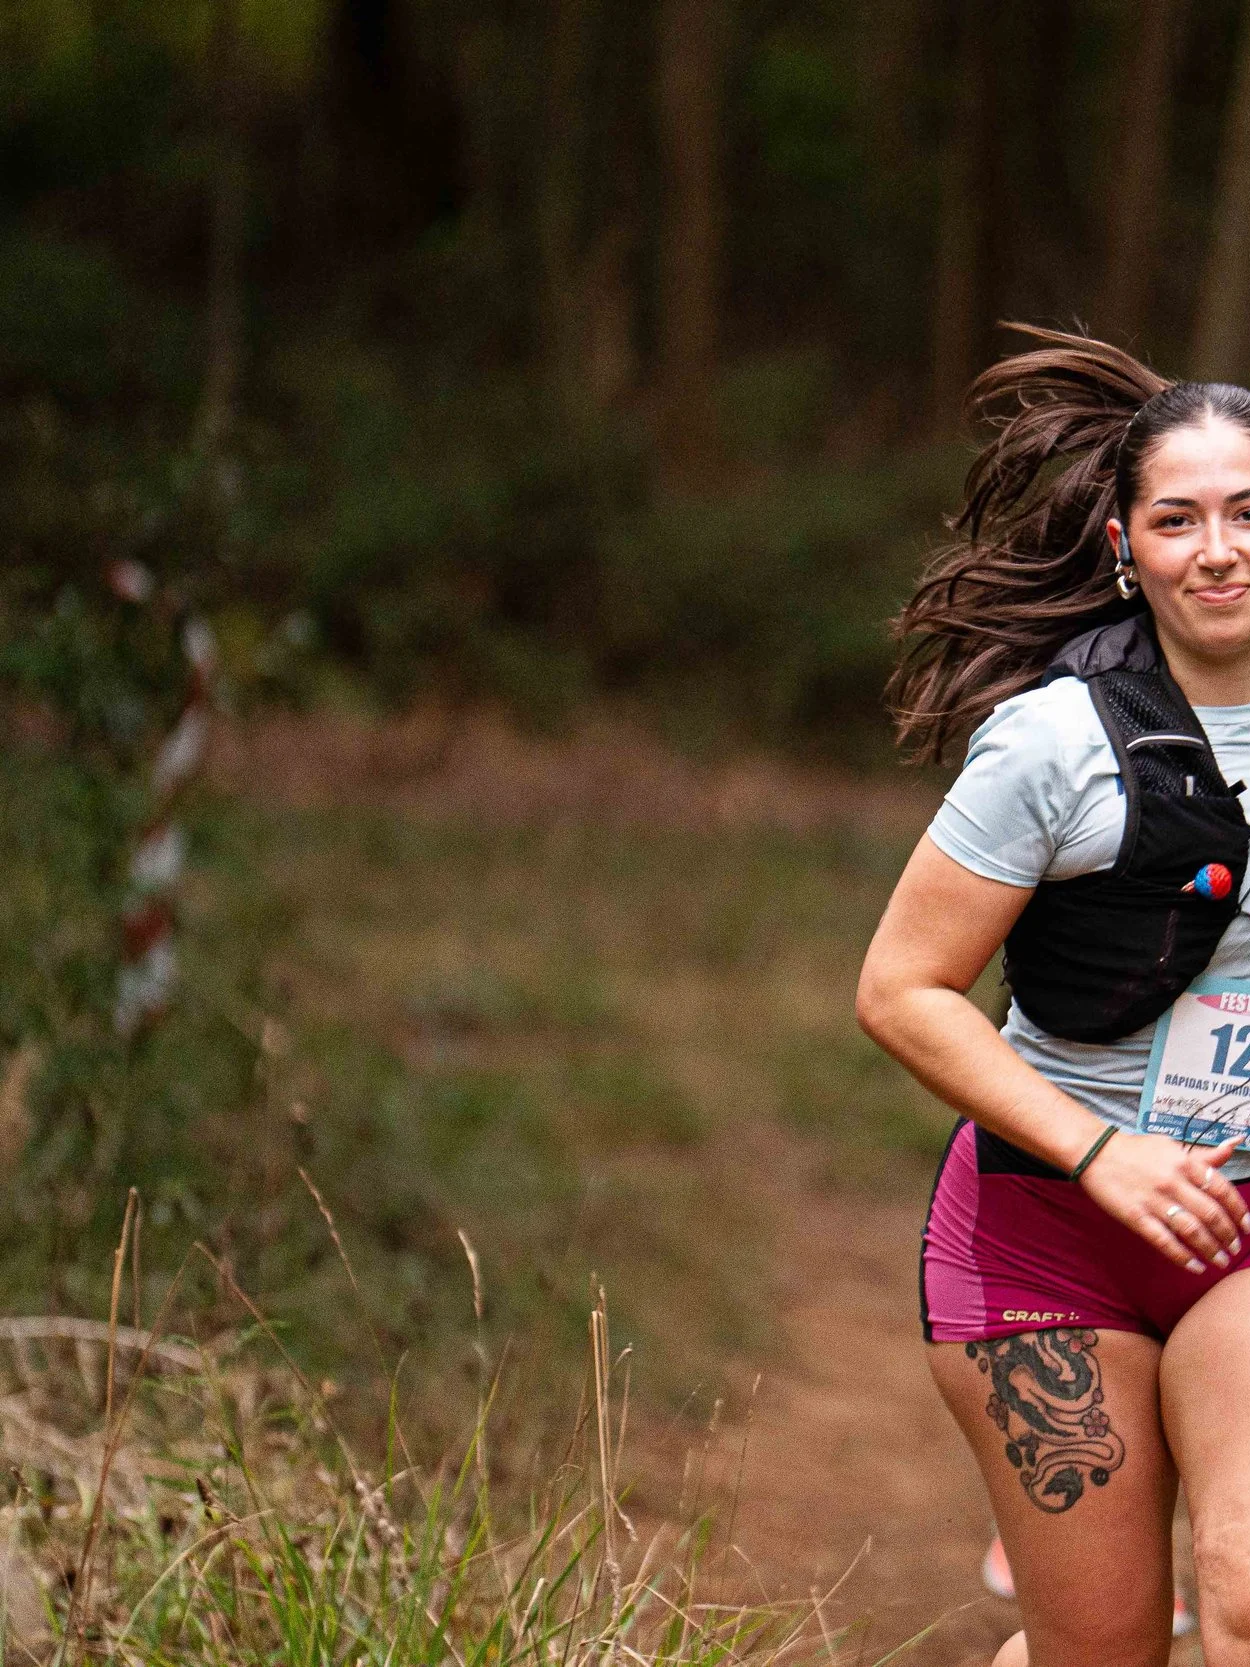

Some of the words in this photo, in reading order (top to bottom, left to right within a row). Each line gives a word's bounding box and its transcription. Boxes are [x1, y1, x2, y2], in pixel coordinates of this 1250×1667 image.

[1164, 1073, 1209, 1091] RÁPIDAS
[1211, 1080, 1218, 1091] Y
[1002, 1309, 1066, 1323] CRAFT
